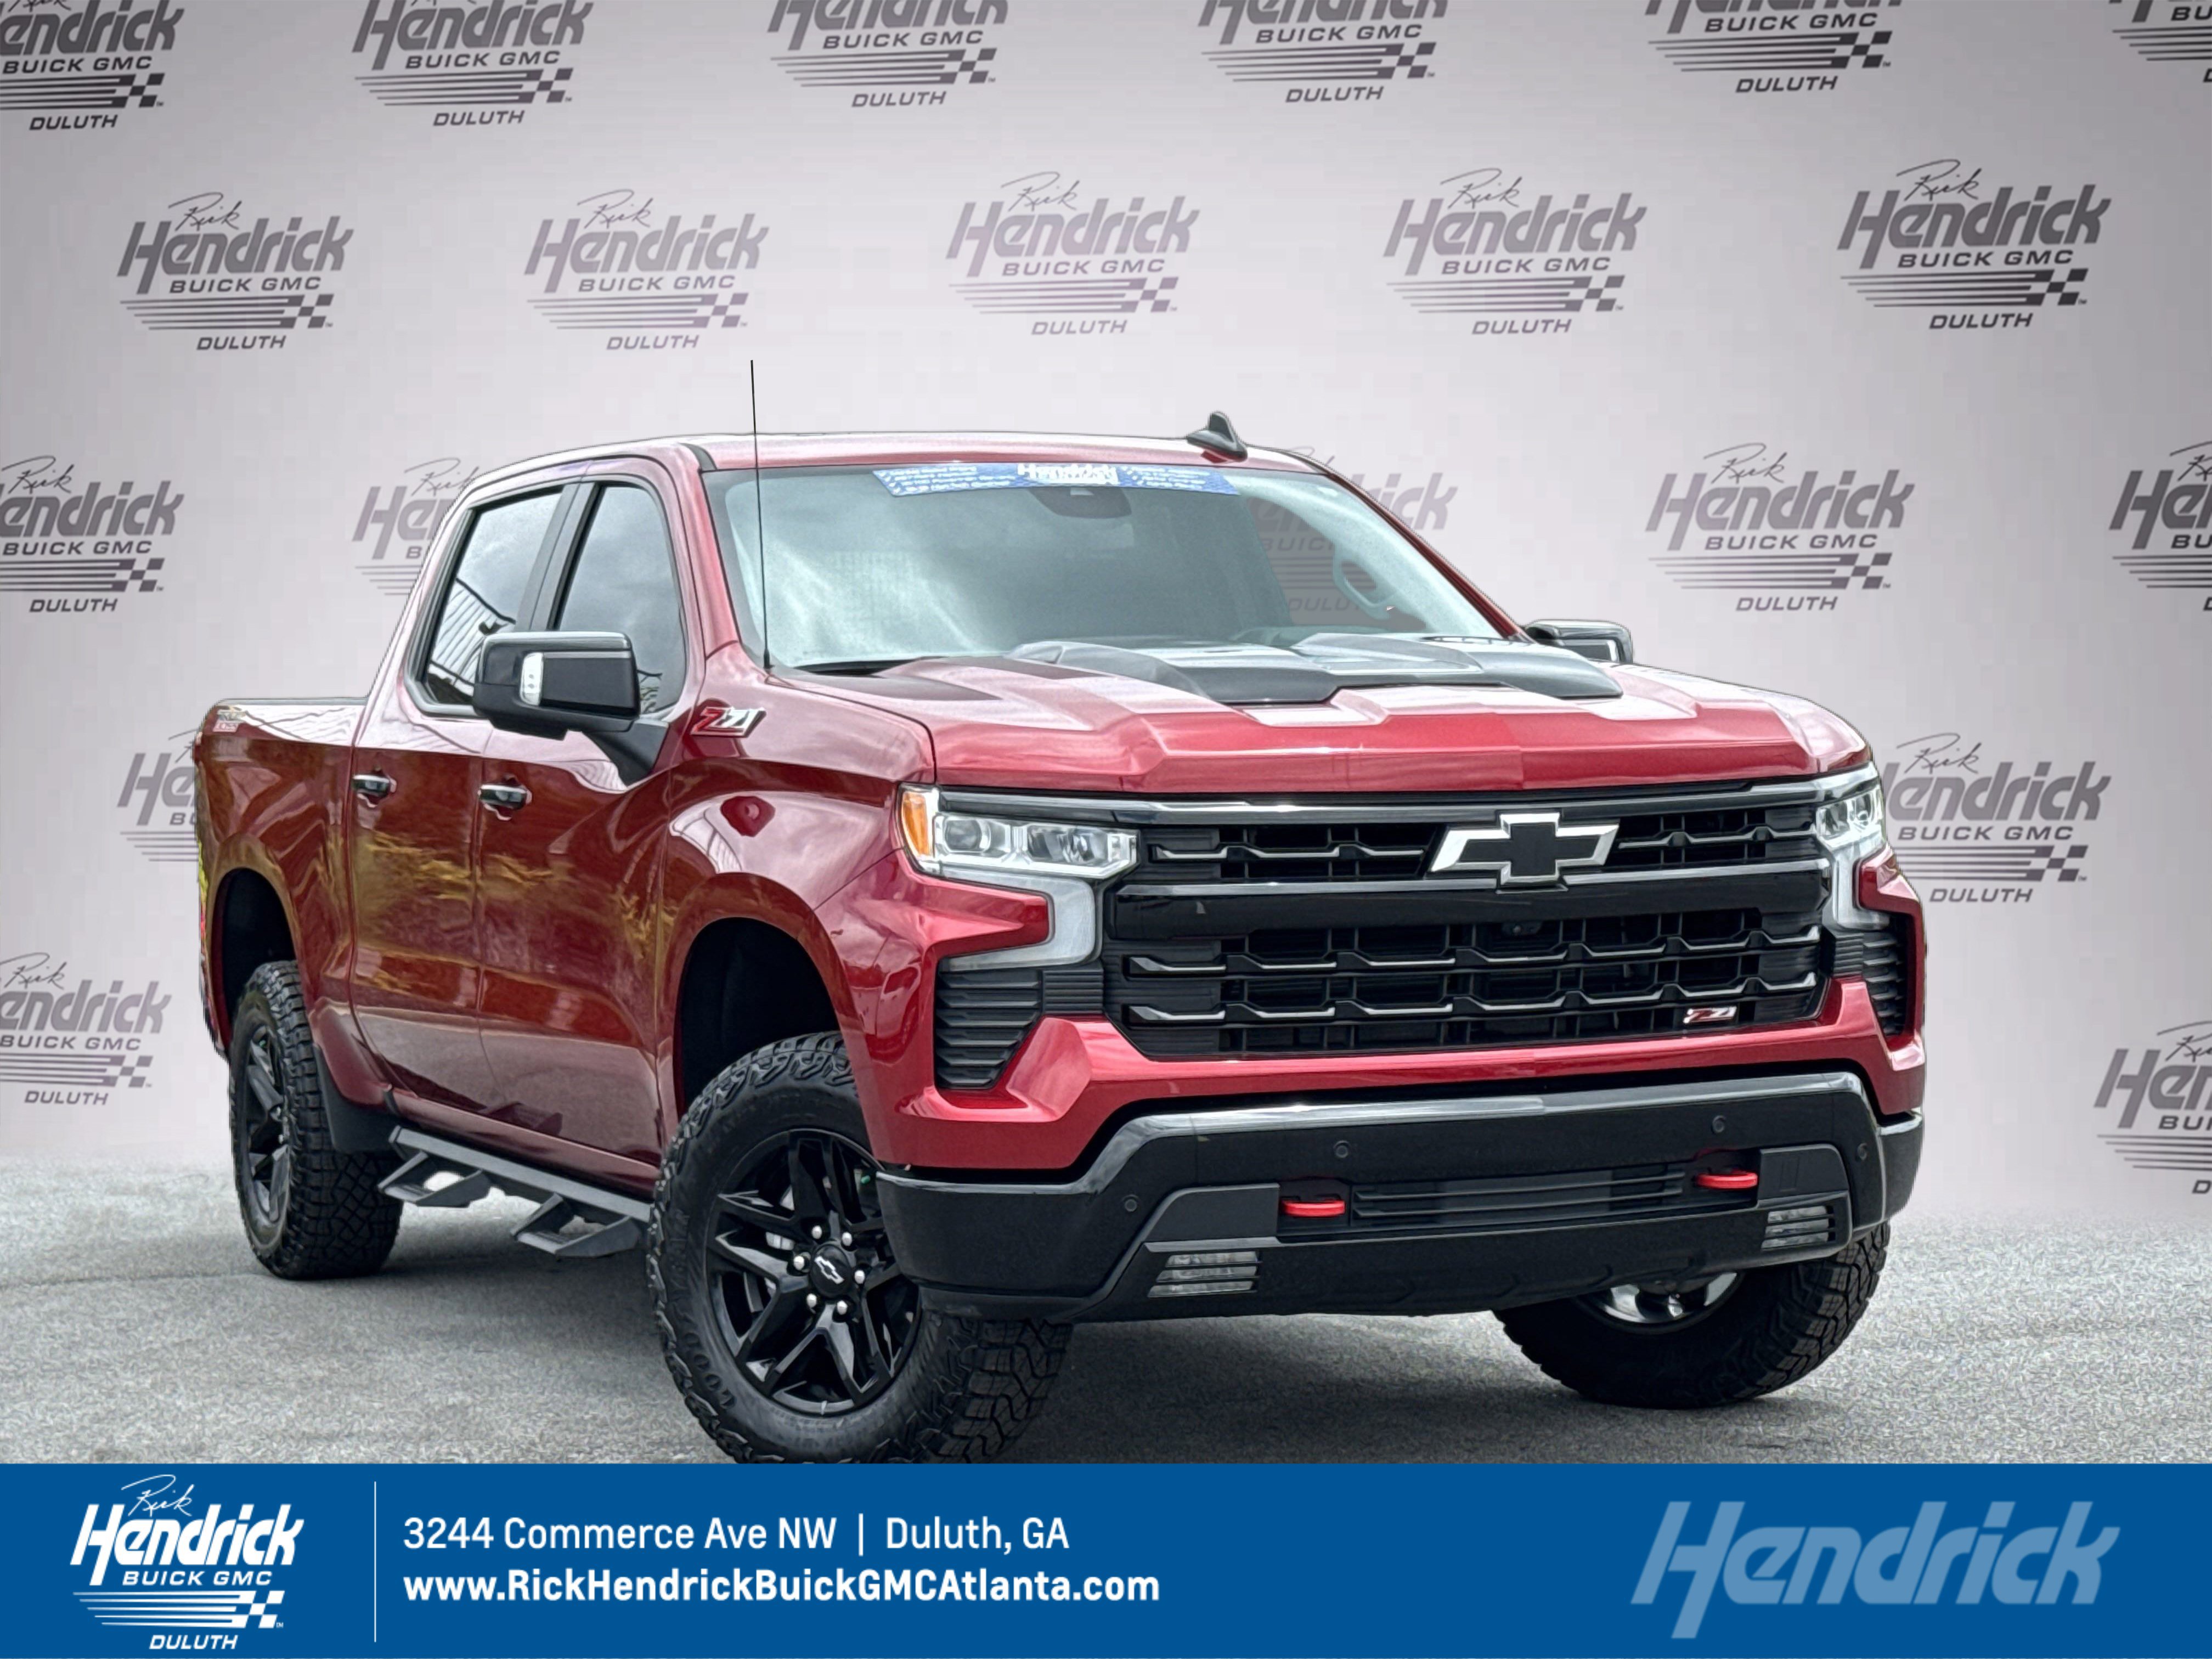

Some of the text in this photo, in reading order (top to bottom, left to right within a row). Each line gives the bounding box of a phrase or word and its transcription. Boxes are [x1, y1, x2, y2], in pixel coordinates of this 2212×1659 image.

[0, 0, 184, 55] endrick
[1705, 15, 1799, 32] BUICK
[1809, 13, 1877, 29] GMC
[352, 0, 594, 70] Hendrick
[823, 30, 983, 49] BUICK GMC
[1256, 24, 1422, 43] BUICK GMC
[3, 56, 152, 74] BUICK GMC
[405, 50, 560, 69] BUICK GMC
[1736, 76, 1838, 93] DULUTH
[852, 91, 946, 107] DULUTH
[1286, 86, 1384, 103] DULUTH
[30, 115, 118, 130] DULUTH
[433, 110, 524, 126] DULUTH
[1384, 193, 1647, 275] Hendrick
[1838, 184, 2112, 269] Hendrick
[946, 196, 1200, 278] Hendrick
[117, 216, 353, 295] Hendrick
[524, 213, 769, 294] Hendrick
[1898, 250, 2073, 268] BUICK GMC
[1002, 259, 1165, 276] BUICK GMC
[1442, 257, 1610, 274] BUICK GMC
[170, 276, 321, 293] BUICK GMC
[578, 275, 735, 292] BUICK GMC
[1031, 320, 1127, 335] DULUTH
[1472, 319, 1572, 334] DULUTH
[1929, 313, 2033, 329] DULUTH
[196, 336, 286, 350] DULUTH
[607, 335, 699, 350] DULUTH
[0, 481, 184, 538] endrick
[1646, 470, 1916, 551] Hendrick
[3, 541, 151, 556] BUICK GMC
[1262, 537, 1334, 552] BUIC
[1705, 534, 1877, 550] BUICK GMC
[30, 599, 117, 612] DULUTH
[1736, 596, 1838, 611] DULUTH
[1898, 826, 2073, 840] BUICK GMC
[1930, 888, 2033, 902] DULUTH
[0, 980, 172, 1034] endrick
[0, 1035, 140, 1051] BUICK GMC
[24, 1091, 108, 1105] DULUTH
